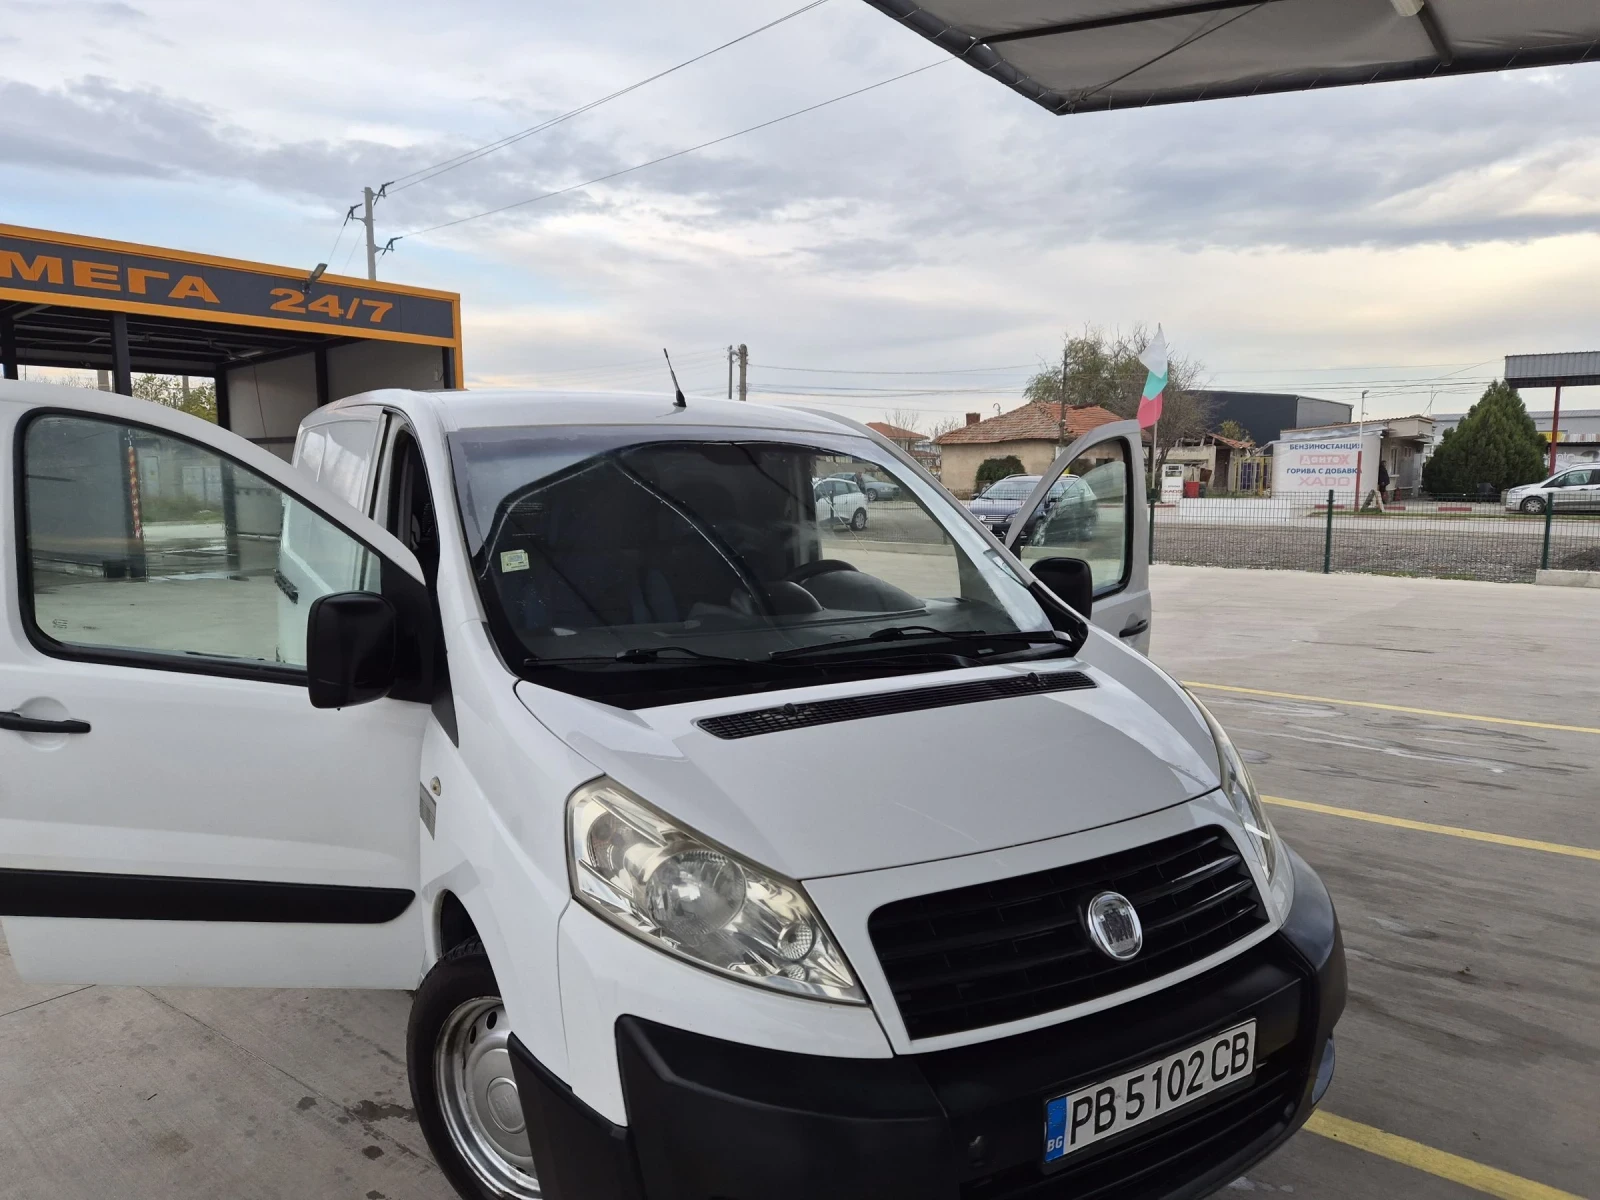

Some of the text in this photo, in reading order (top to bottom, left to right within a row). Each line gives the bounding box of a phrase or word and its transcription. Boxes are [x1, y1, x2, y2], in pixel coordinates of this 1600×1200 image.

[0, 251, 393, 323] МЕГА 24/7
[1125, 1050, 1204, 1121] 5102
[1047, 1136, 1063, 1152] BG
